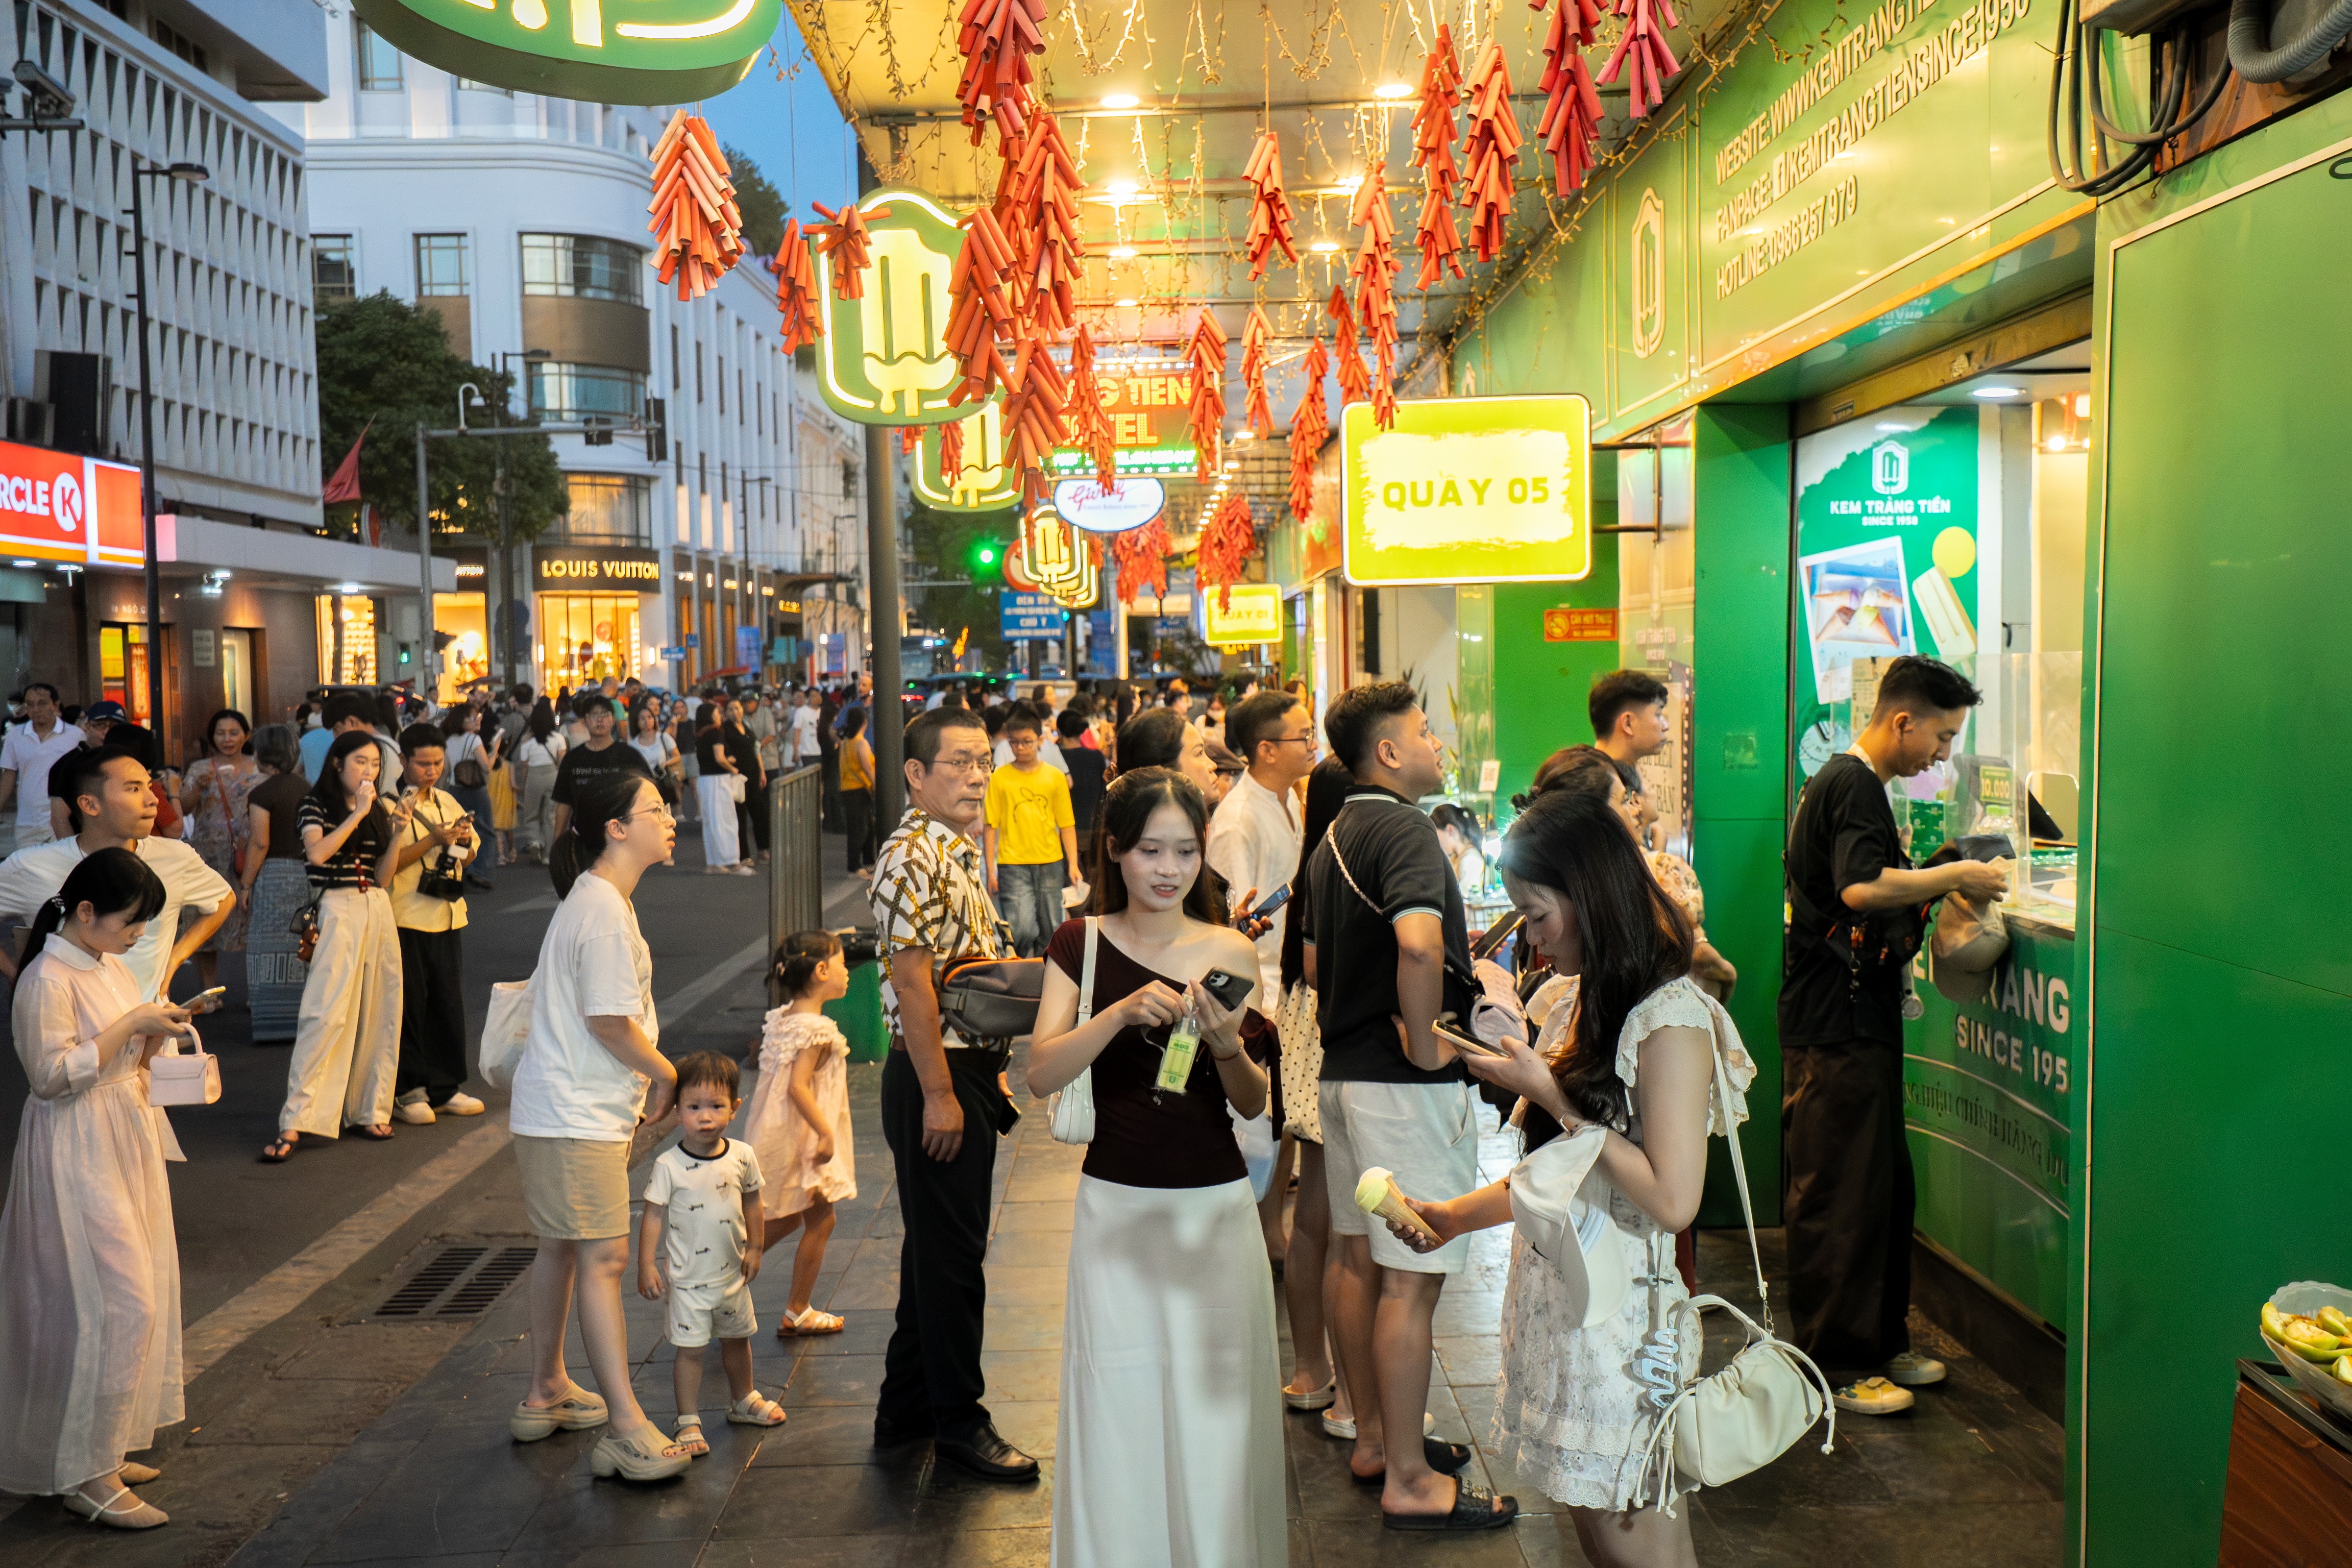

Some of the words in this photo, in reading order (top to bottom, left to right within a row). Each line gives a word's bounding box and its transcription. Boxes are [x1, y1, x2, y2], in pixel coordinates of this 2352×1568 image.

[1716, 110, 1771, 186] WEBSITE:
[1716, 172, 1773, 243] FANPAGE:
[1717, 237, 1769, 301] HOTLINE:
[1769, 213, 1801, 266] 0986
[1801, 195, 1827, 247] 257
[1828, 175, 1857, 228] 979
[1508, 477, 1549, 504] 05
[1830, 500, 1862, 514] KEM
[1865, 496, 1915, 514] TRÀNG
[1861, 516, 1894, 526] SINCE
[542, 560, 598, 578] LOUIS
[602, 560, 659, 580] VUITTON
[1956, 1015, 2023, 1075] SINCE
